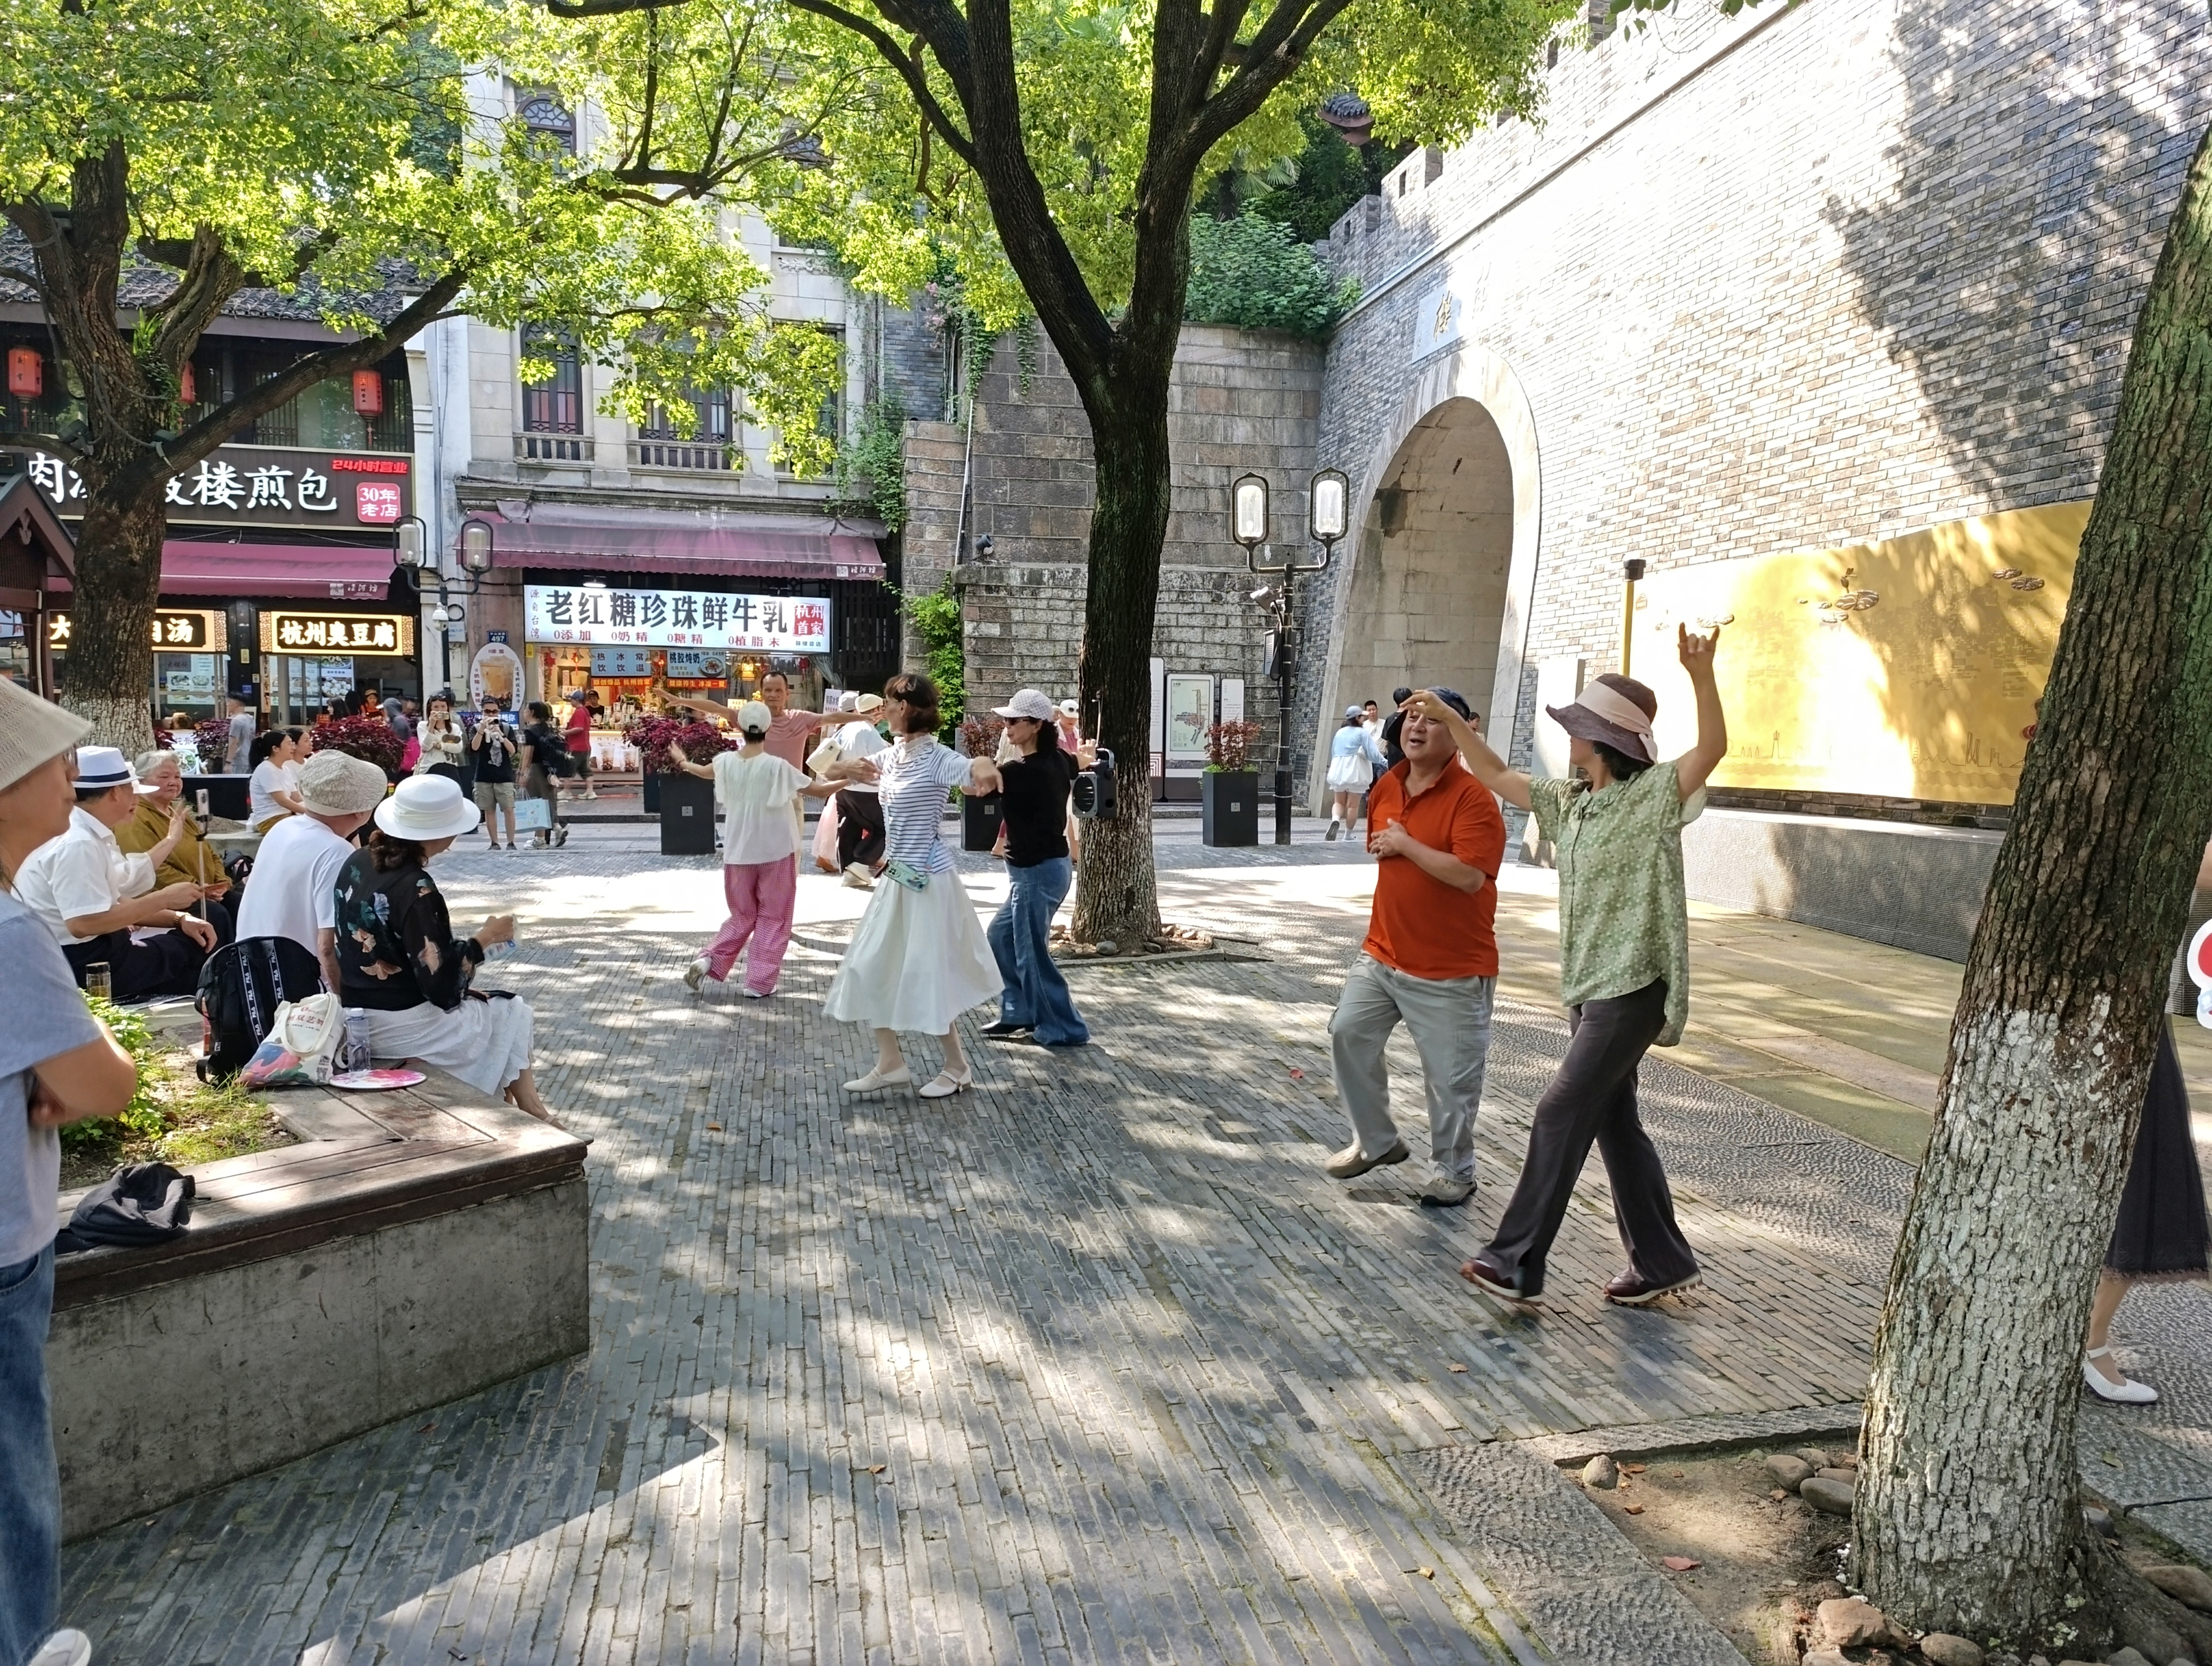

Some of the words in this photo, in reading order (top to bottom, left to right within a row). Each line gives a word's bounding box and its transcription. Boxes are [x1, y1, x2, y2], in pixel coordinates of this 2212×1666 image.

[332, 459, 407, 473] 24小时营业
[359, 487, 397, 503] 30年
[361, 503, 398, 517] 老店
[347, 583, 378, 592] 清河坊
[530, 589, 539, 639] 源自台湾
[546, 589, 788, 633] 老红糖珍珠鲜牛乳
[795, 605, 824, 619] 杭州
[279, 620, 395, 648] 杭州臭豆腐
[796, 621, 824, 635] 首家
[554, 629, 591, 640] 0添加
[611, 631, 648, 642] 0奶精
[667, 633, 703, 644] 0糖精
[728, 636, 780, 647] 0植脂末
[670, 652, 700, 664] 桃胶炖奶
